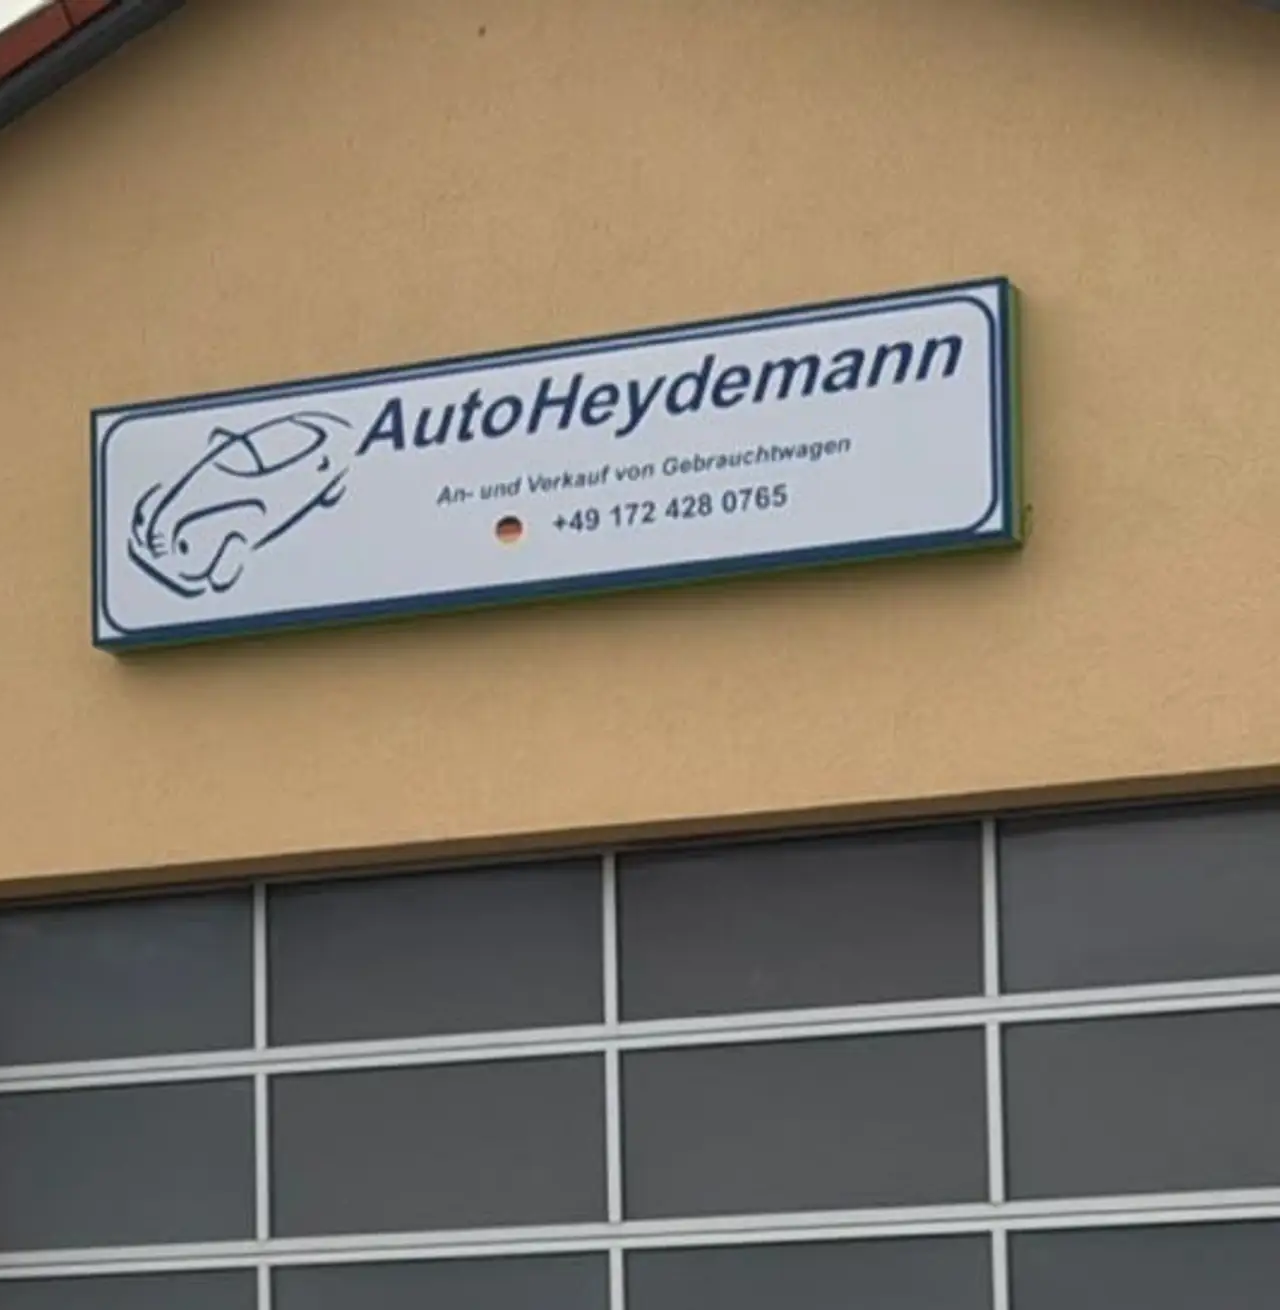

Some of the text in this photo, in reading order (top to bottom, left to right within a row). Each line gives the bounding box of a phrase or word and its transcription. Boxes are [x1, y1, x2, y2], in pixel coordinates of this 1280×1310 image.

[354, 333, 964, 456] AutoHeydemann
[436, 437, 851, 505] An- und Verkauf von Gebrauchtwagen
[553, 483, 788, 532] +49 172 428 0765
